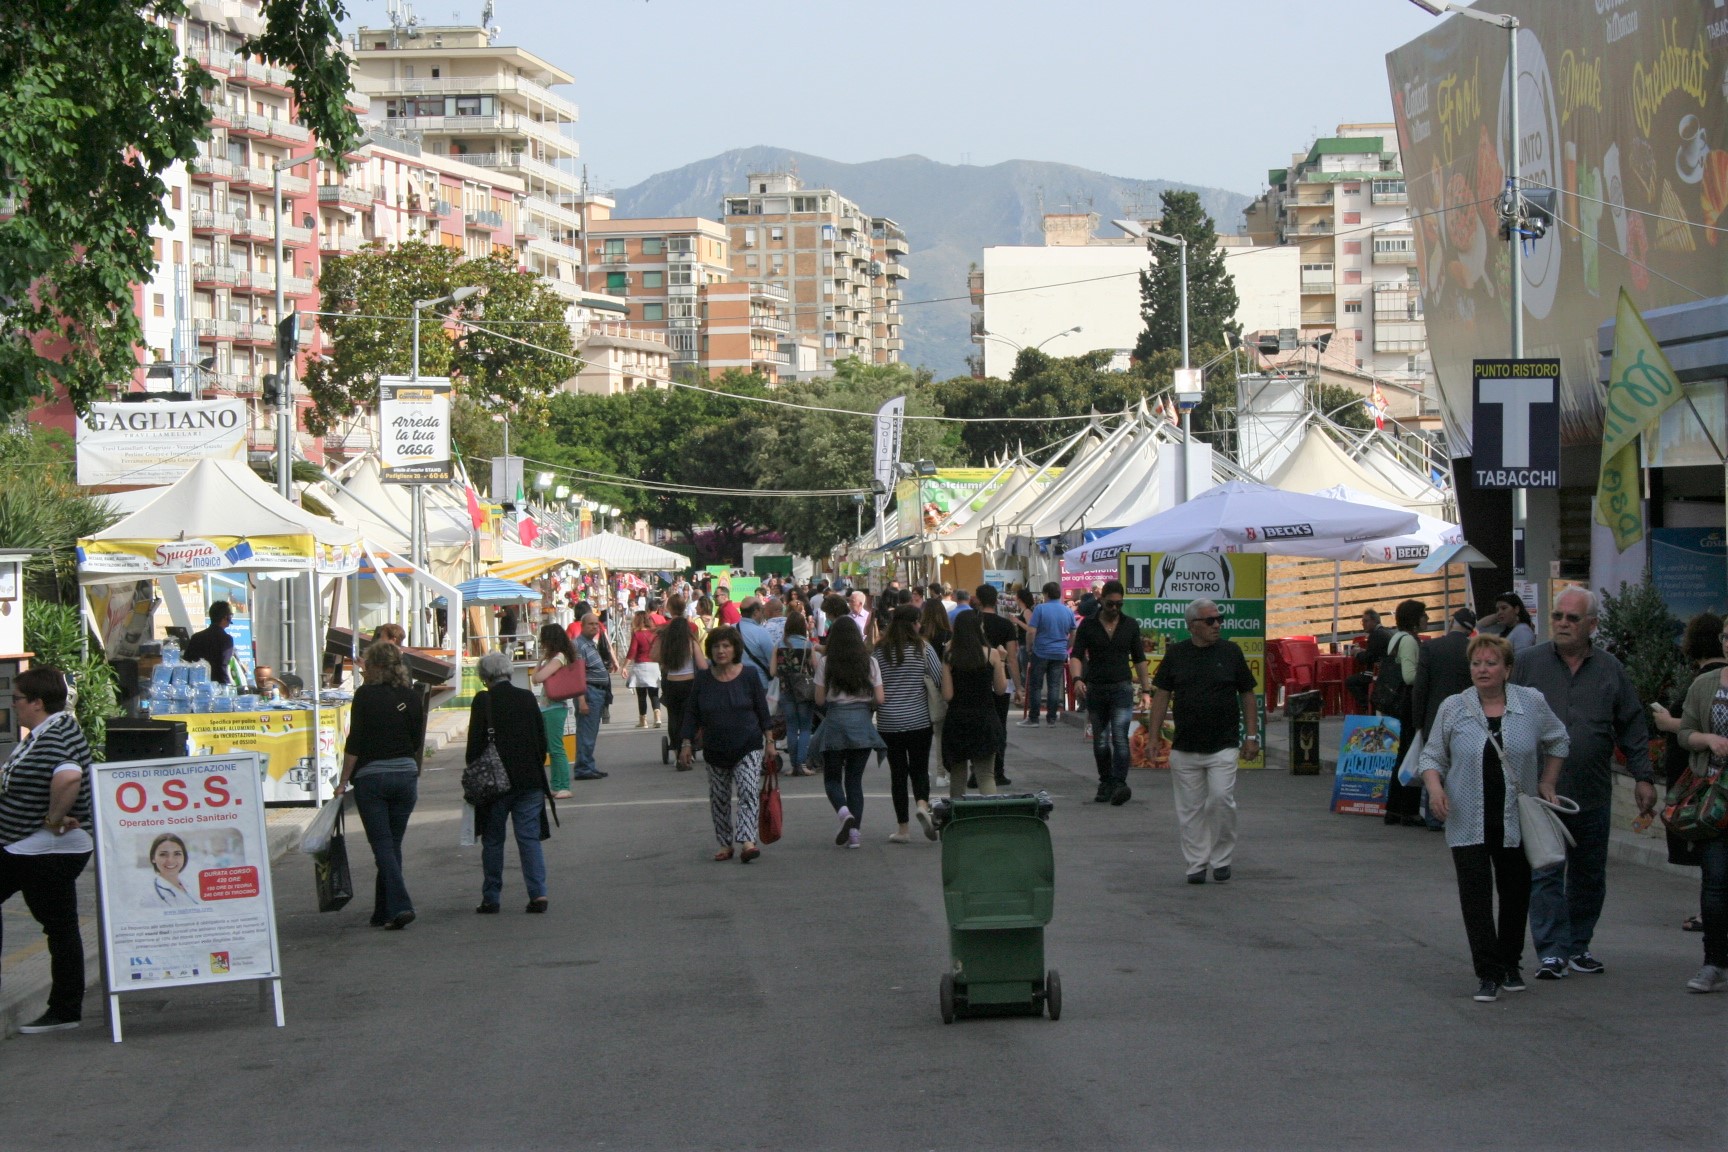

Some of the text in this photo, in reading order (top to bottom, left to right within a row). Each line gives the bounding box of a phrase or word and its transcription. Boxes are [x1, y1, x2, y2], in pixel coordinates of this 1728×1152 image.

[1633, 16, 1709, 138] Breakfast
[1559, 47, 1602, 127] Drink
[1437, 55, 1481, 167] Food
[1519, 131, 1543, 168] UNTO
[1475, 363, 1559, 377] PUNTO RISTORO
[93, 409, 238, 431] GAGLIANO
[392, 416, 440, 428] Arreda
[1479, 378, 1554, 468] T
[395, 429, 435, 441] la tua
[397, 443, 435, 455] casa
[1476, 470, 1557, 486] TABACCHI
[1266, 525, 1313, 538] BECK'S
[152, 544, 214, 567] Spugna
[1093, 544, 1130, 561] BECK'S
[1398, 545, 1429, 559] BECK'S
[193, 556, 221, 568] magica
[1175, 571, 1216, 580] PUNTO
[1171, 583, 1220, 592] RISTORO
[1154, 603, 1189, 614] PANI
[111, 771, 140, 779] CORSI
[154, 763, 237, 777] RIQUALIFICAZIONE
[115, 775, 243, 813] O.S.S.
[119, 812, 238, 828] Operatore Socio Sanitario
[130, 956, 153, 966] ISA
